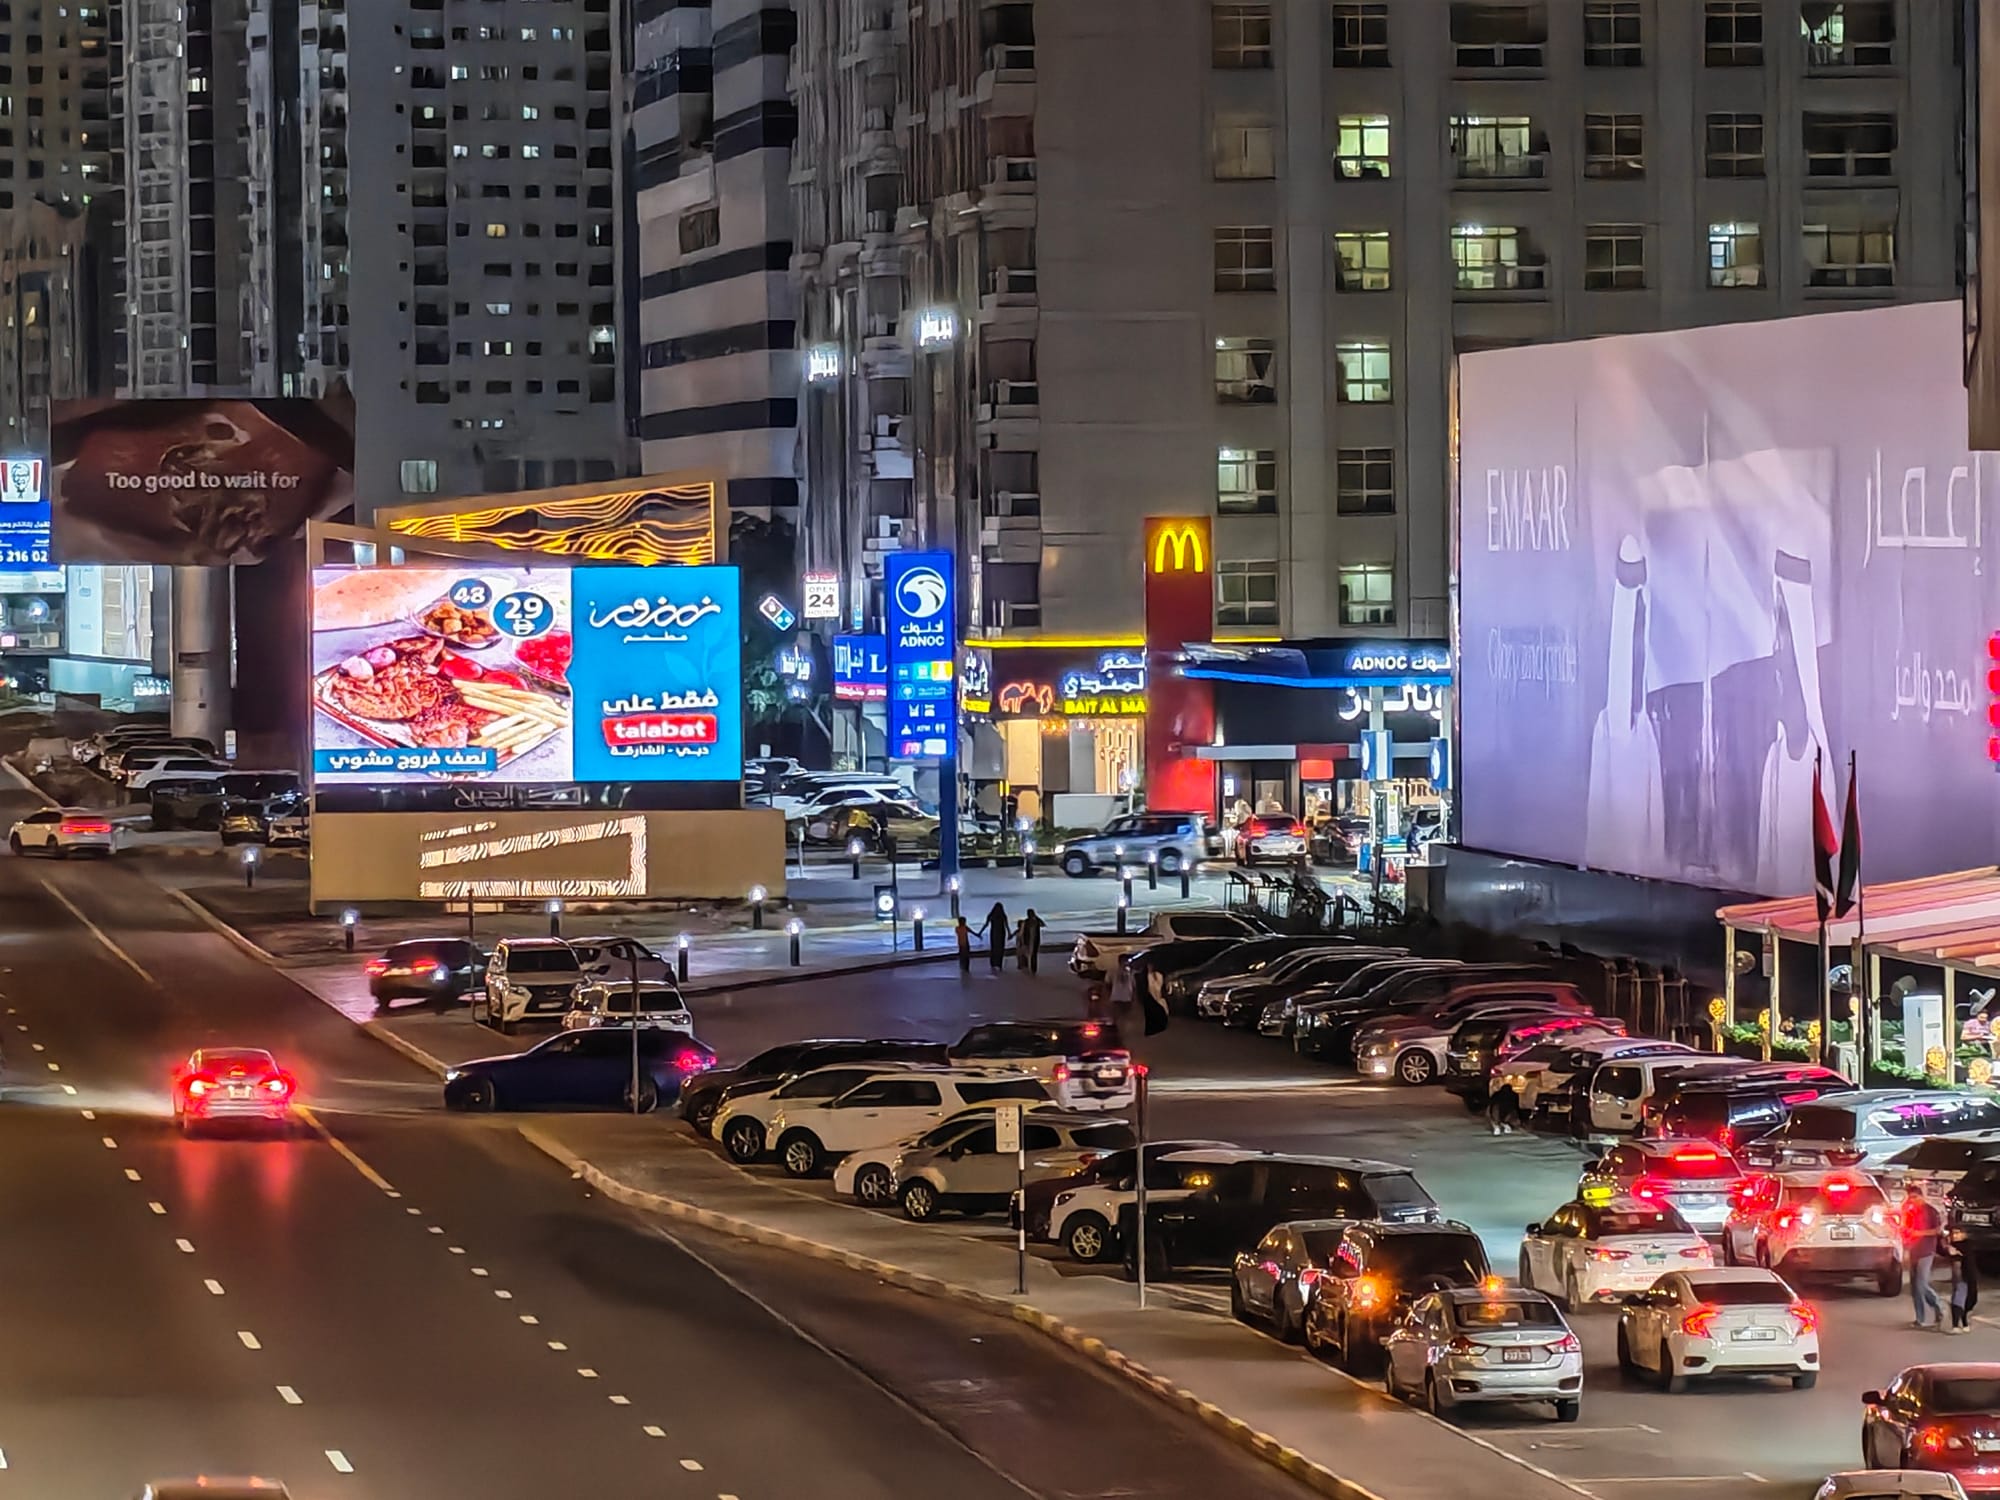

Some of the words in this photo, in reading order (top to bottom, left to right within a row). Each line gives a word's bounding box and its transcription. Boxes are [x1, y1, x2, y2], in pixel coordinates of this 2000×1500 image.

[105, 472, 141, 489] Too
[145, 470, 196, 494] good
[200, 472, 221, 489] to
[224, 470, 268, 489] wait
[271, 471, 300, 489] for
[1486, 464, 1570, 551] EMAAR
[1863, 447, 1982, 576] إعمار
[453, 586, 486, 604] 48
[808, 594, 835, 608] 24
[503, 596, 544, 619] 29
[899, 636, 945, 648] ADNOC
[1351, 655, 1408, 671] ADNOC
[602, 694, 657, 714] على
[660, 687, 719, 710] فقط
[1064, 700, 1097, 714] BAIT
[1100, 700, 1119, 714] AL
[614, 720, 707, 739] talabat
[329, 750, 394, 770] مشوي
[396, 750, 441, 770] فروج
[444, 751, 487, 766] نصف
[610, 744, 665, 758] الشارقة
[675, 747, 709, 758] دبي
